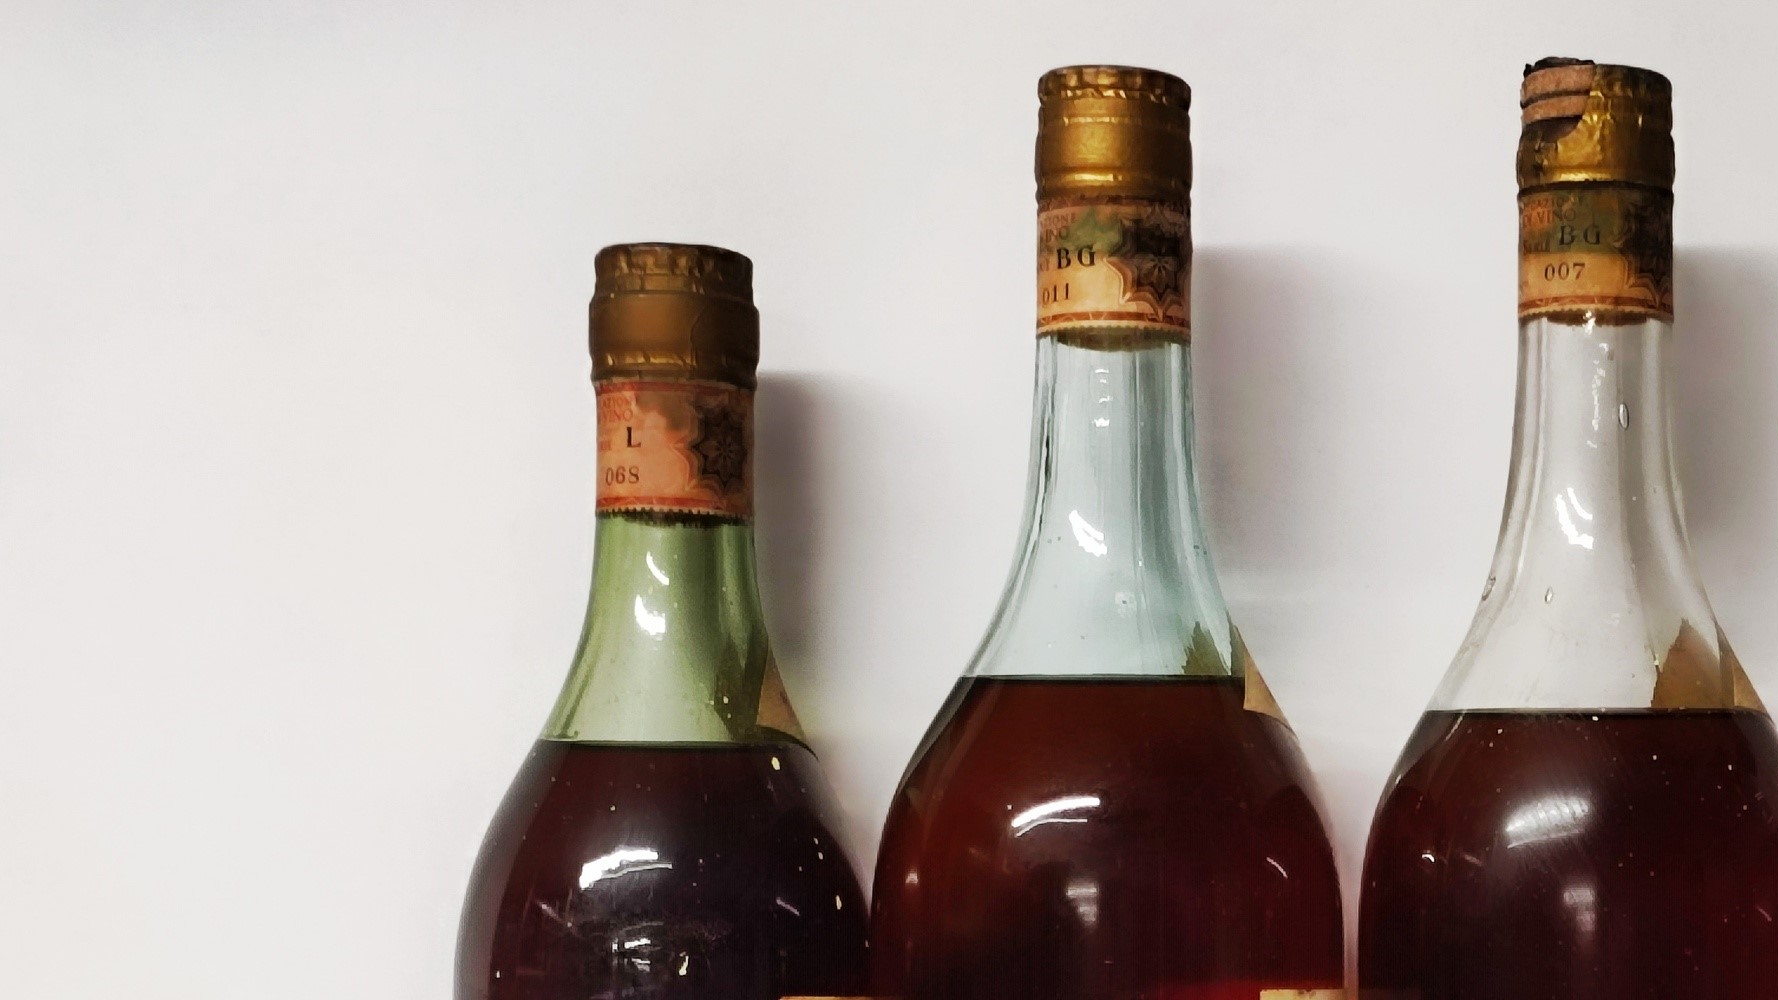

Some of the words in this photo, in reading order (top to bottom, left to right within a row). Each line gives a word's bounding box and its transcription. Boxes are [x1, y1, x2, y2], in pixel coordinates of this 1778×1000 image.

[1543, 261, 1586, 282] 007
[1042, 282, 1070, 307] 011
[626, 426, 642, 448] L
